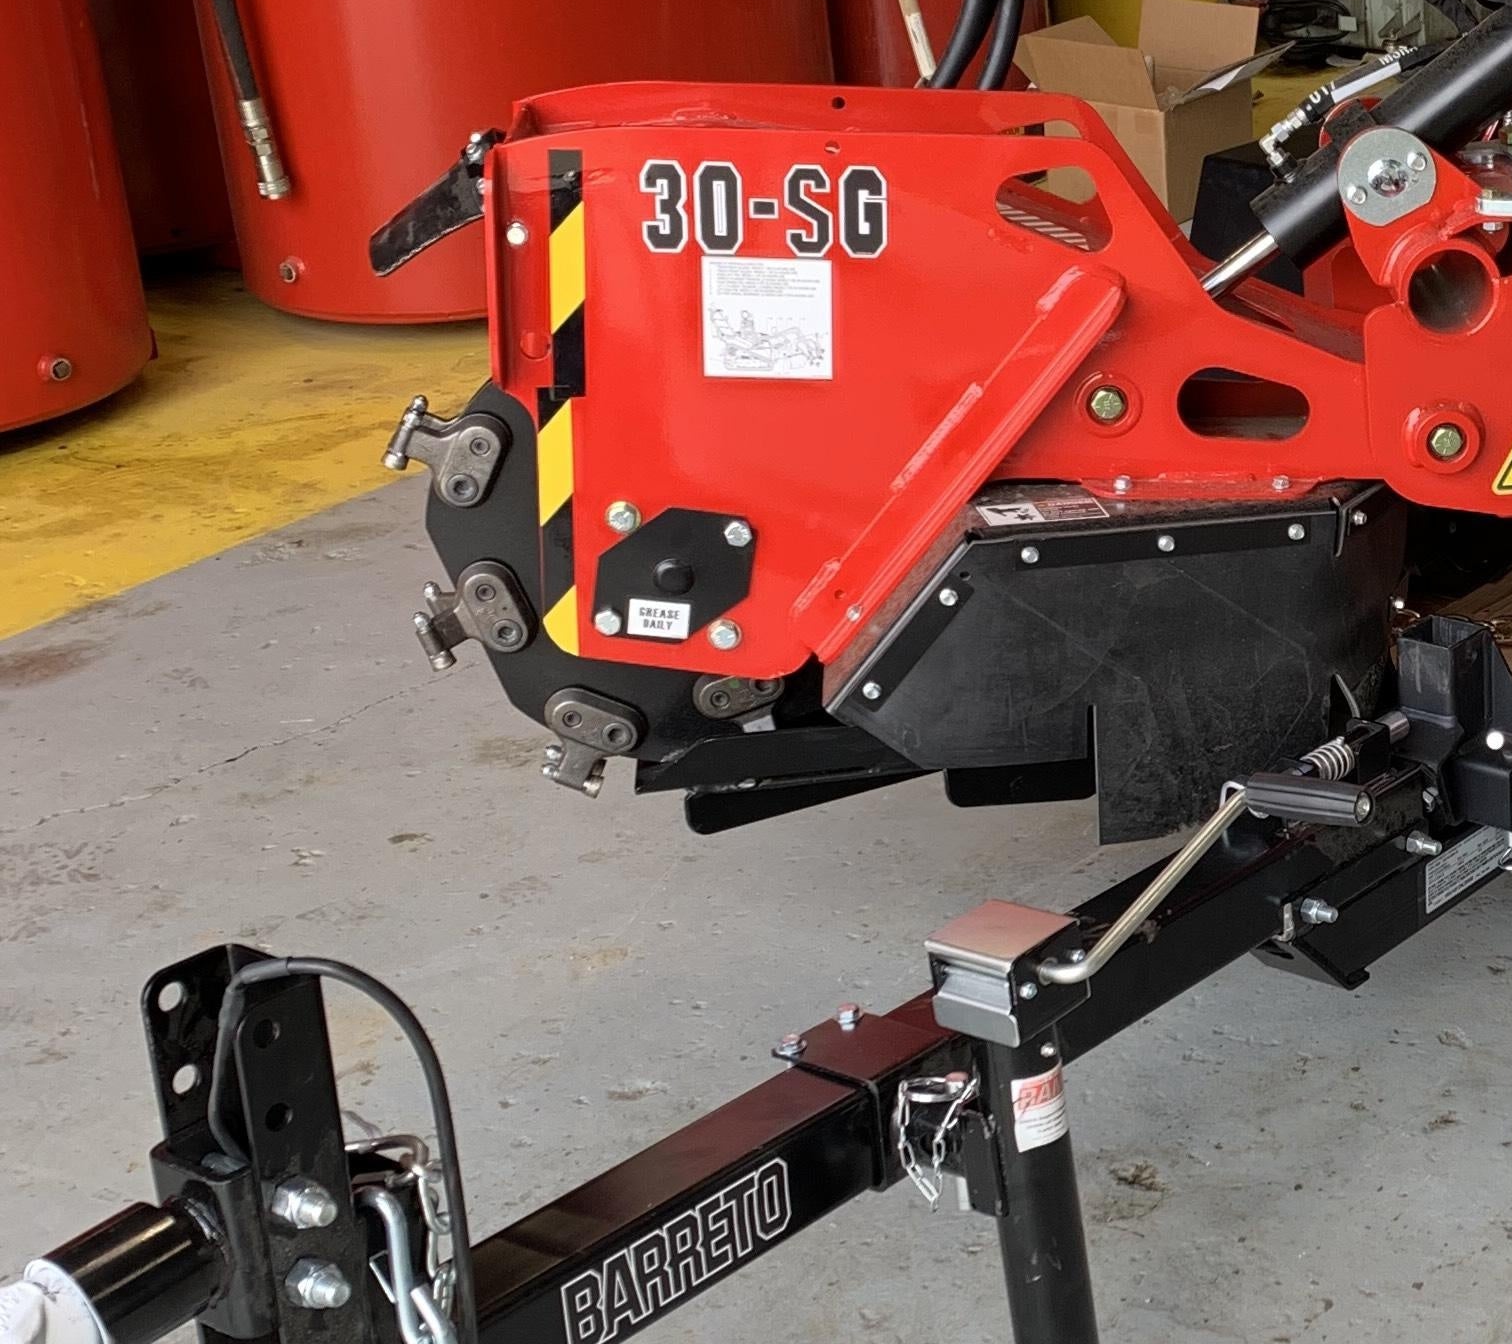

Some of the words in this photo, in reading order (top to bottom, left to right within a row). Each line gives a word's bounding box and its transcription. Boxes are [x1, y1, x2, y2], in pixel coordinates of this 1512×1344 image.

[639, 158, 888, 259] 30-SG
[639, 606, 681, 620] GREASE
[643, 618, 673, 631] DAILY
